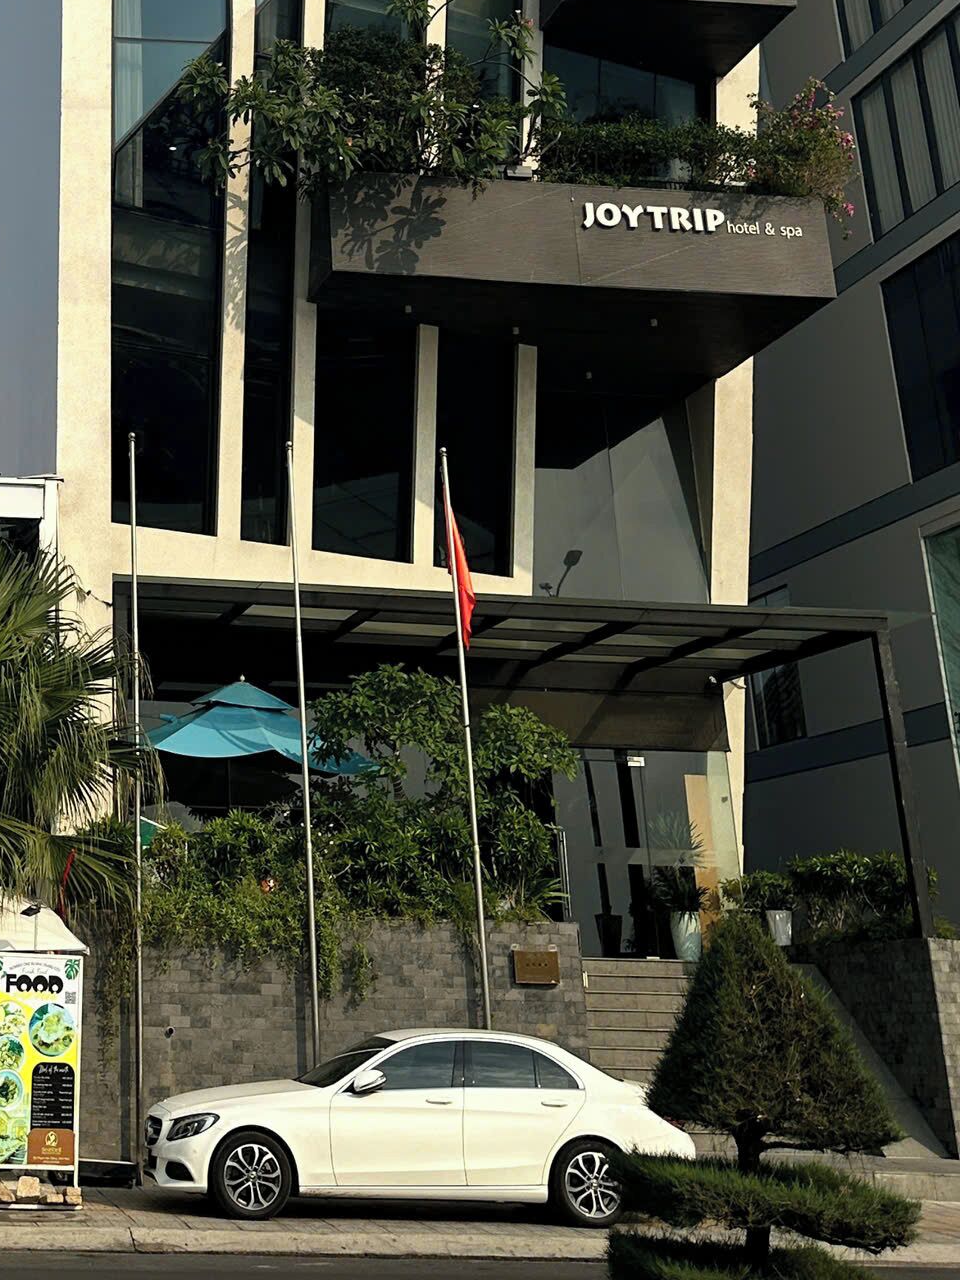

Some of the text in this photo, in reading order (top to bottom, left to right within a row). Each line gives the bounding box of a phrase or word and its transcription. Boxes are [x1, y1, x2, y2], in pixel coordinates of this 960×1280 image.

[582, 202, 803, 240] JOYTRIP hotel & spa
[5, 973, 64, 995] FOOD
